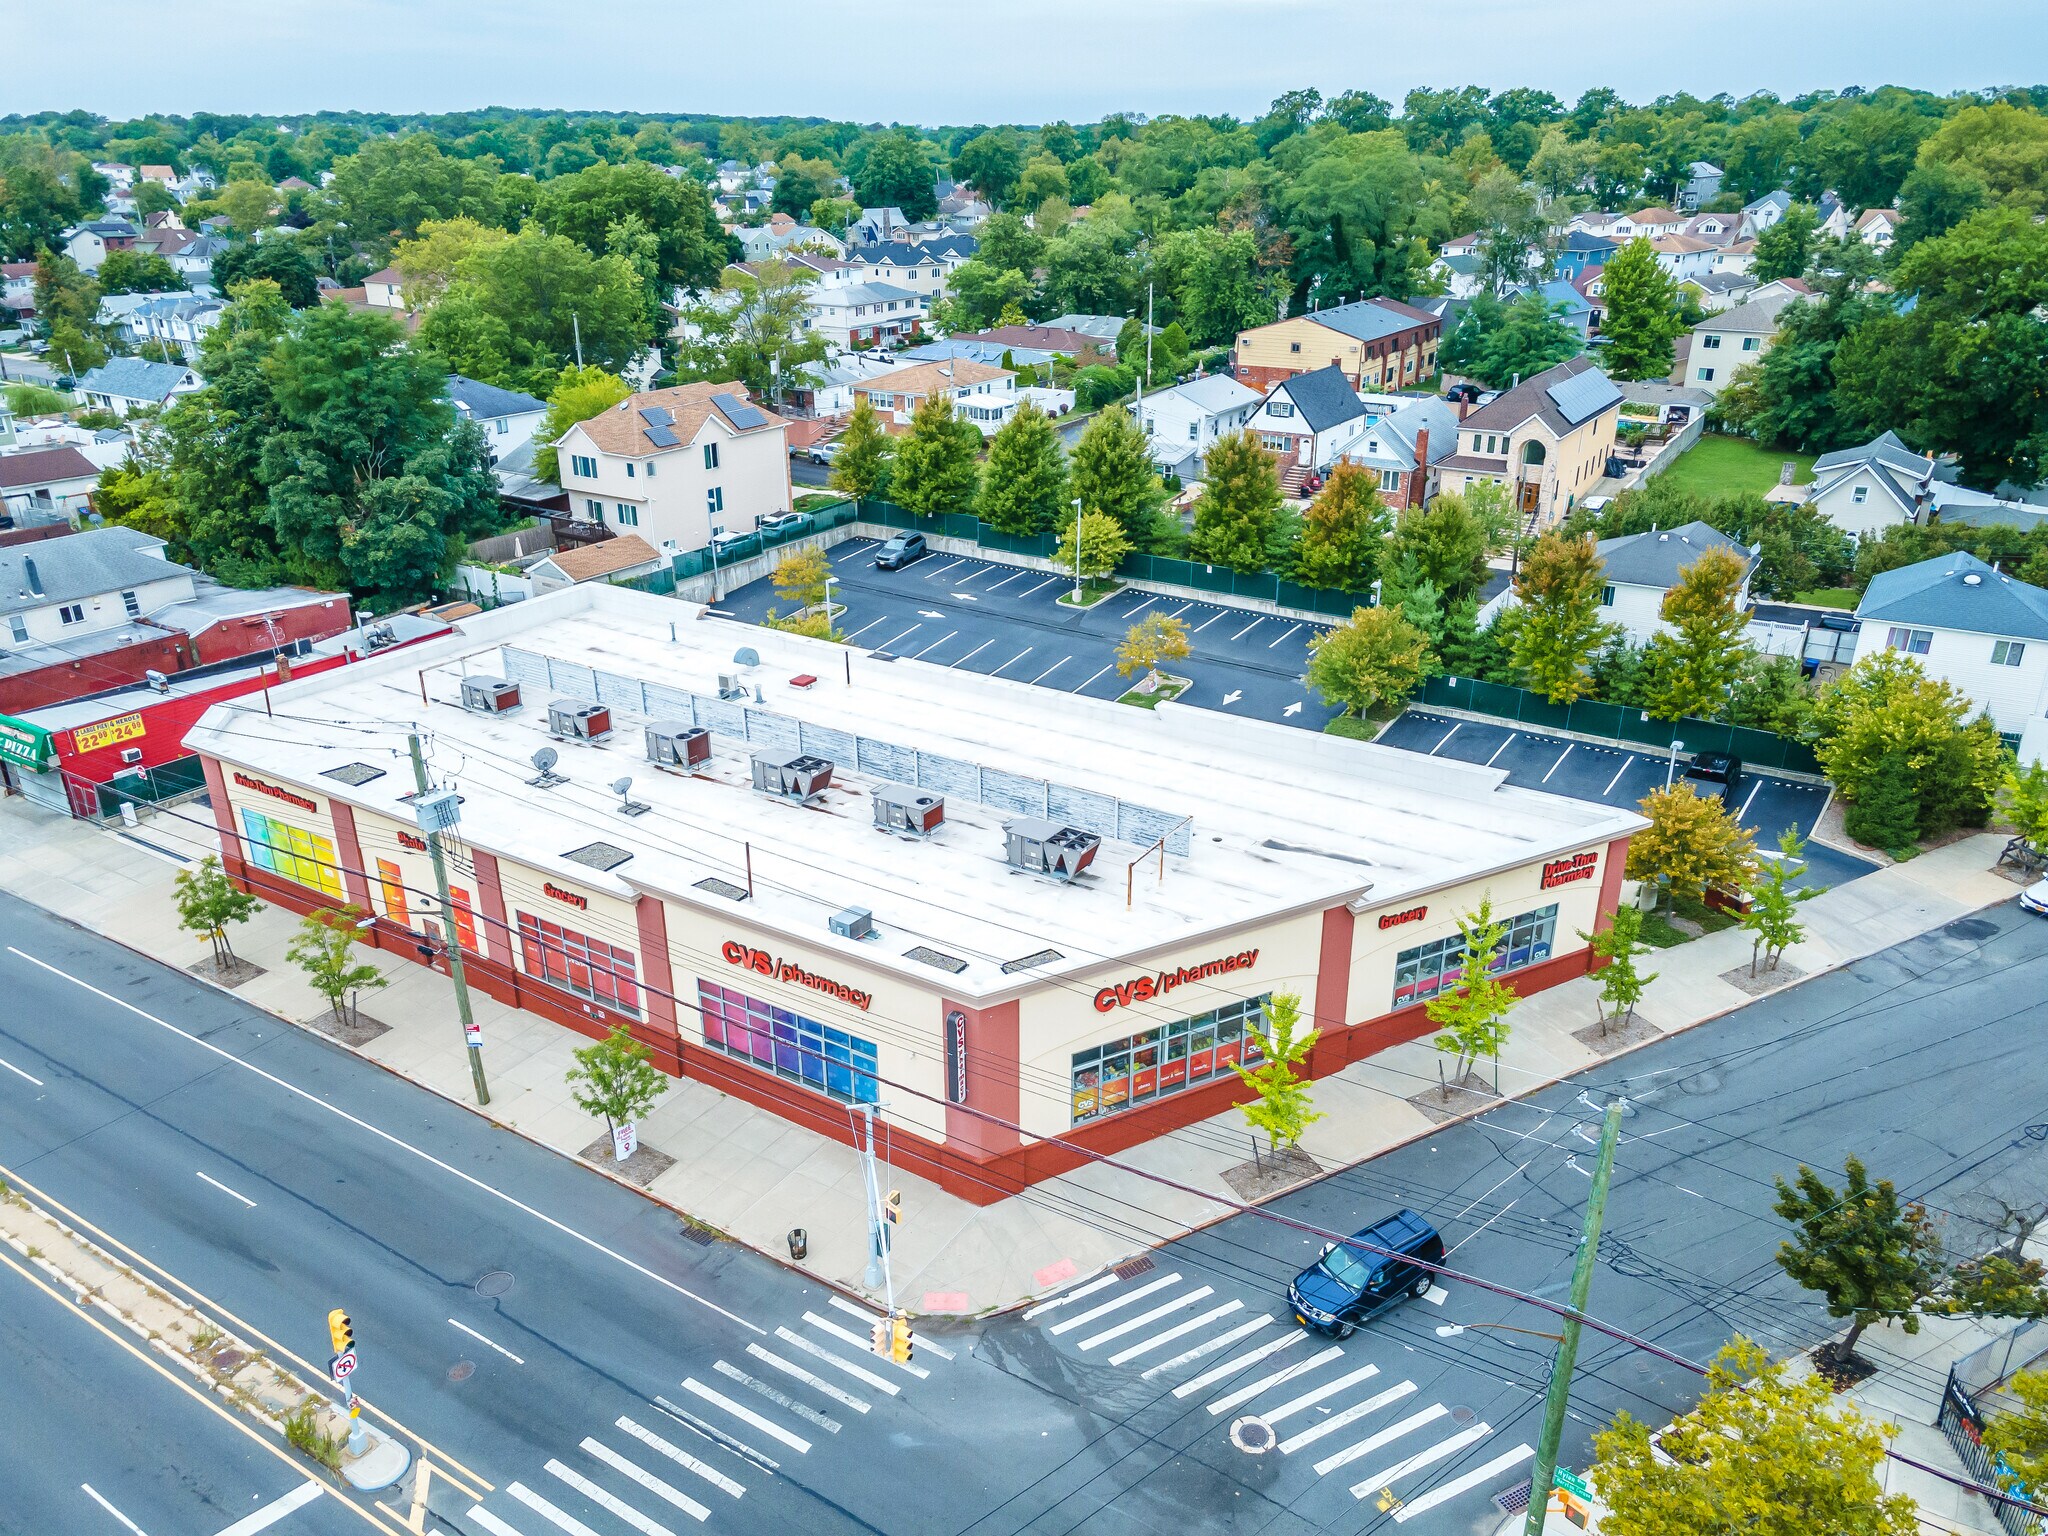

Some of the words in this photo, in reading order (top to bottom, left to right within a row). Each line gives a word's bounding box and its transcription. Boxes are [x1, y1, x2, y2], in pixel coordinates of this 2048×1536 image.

[4, 738, 37, 761] PIZZA
[273, 786, 316, 813] Pharmacy
[397, 831, 427, 851] Photo
[1543, 852, 1599, 877] Drive-Thru
[1540, 865, 1595, 890] Pharmacy
[543, 882, 587, 910] Grocery
[1378, 906, 1428, 930] Grocery
[1557, 1469, 1576, 1483] Hylan
